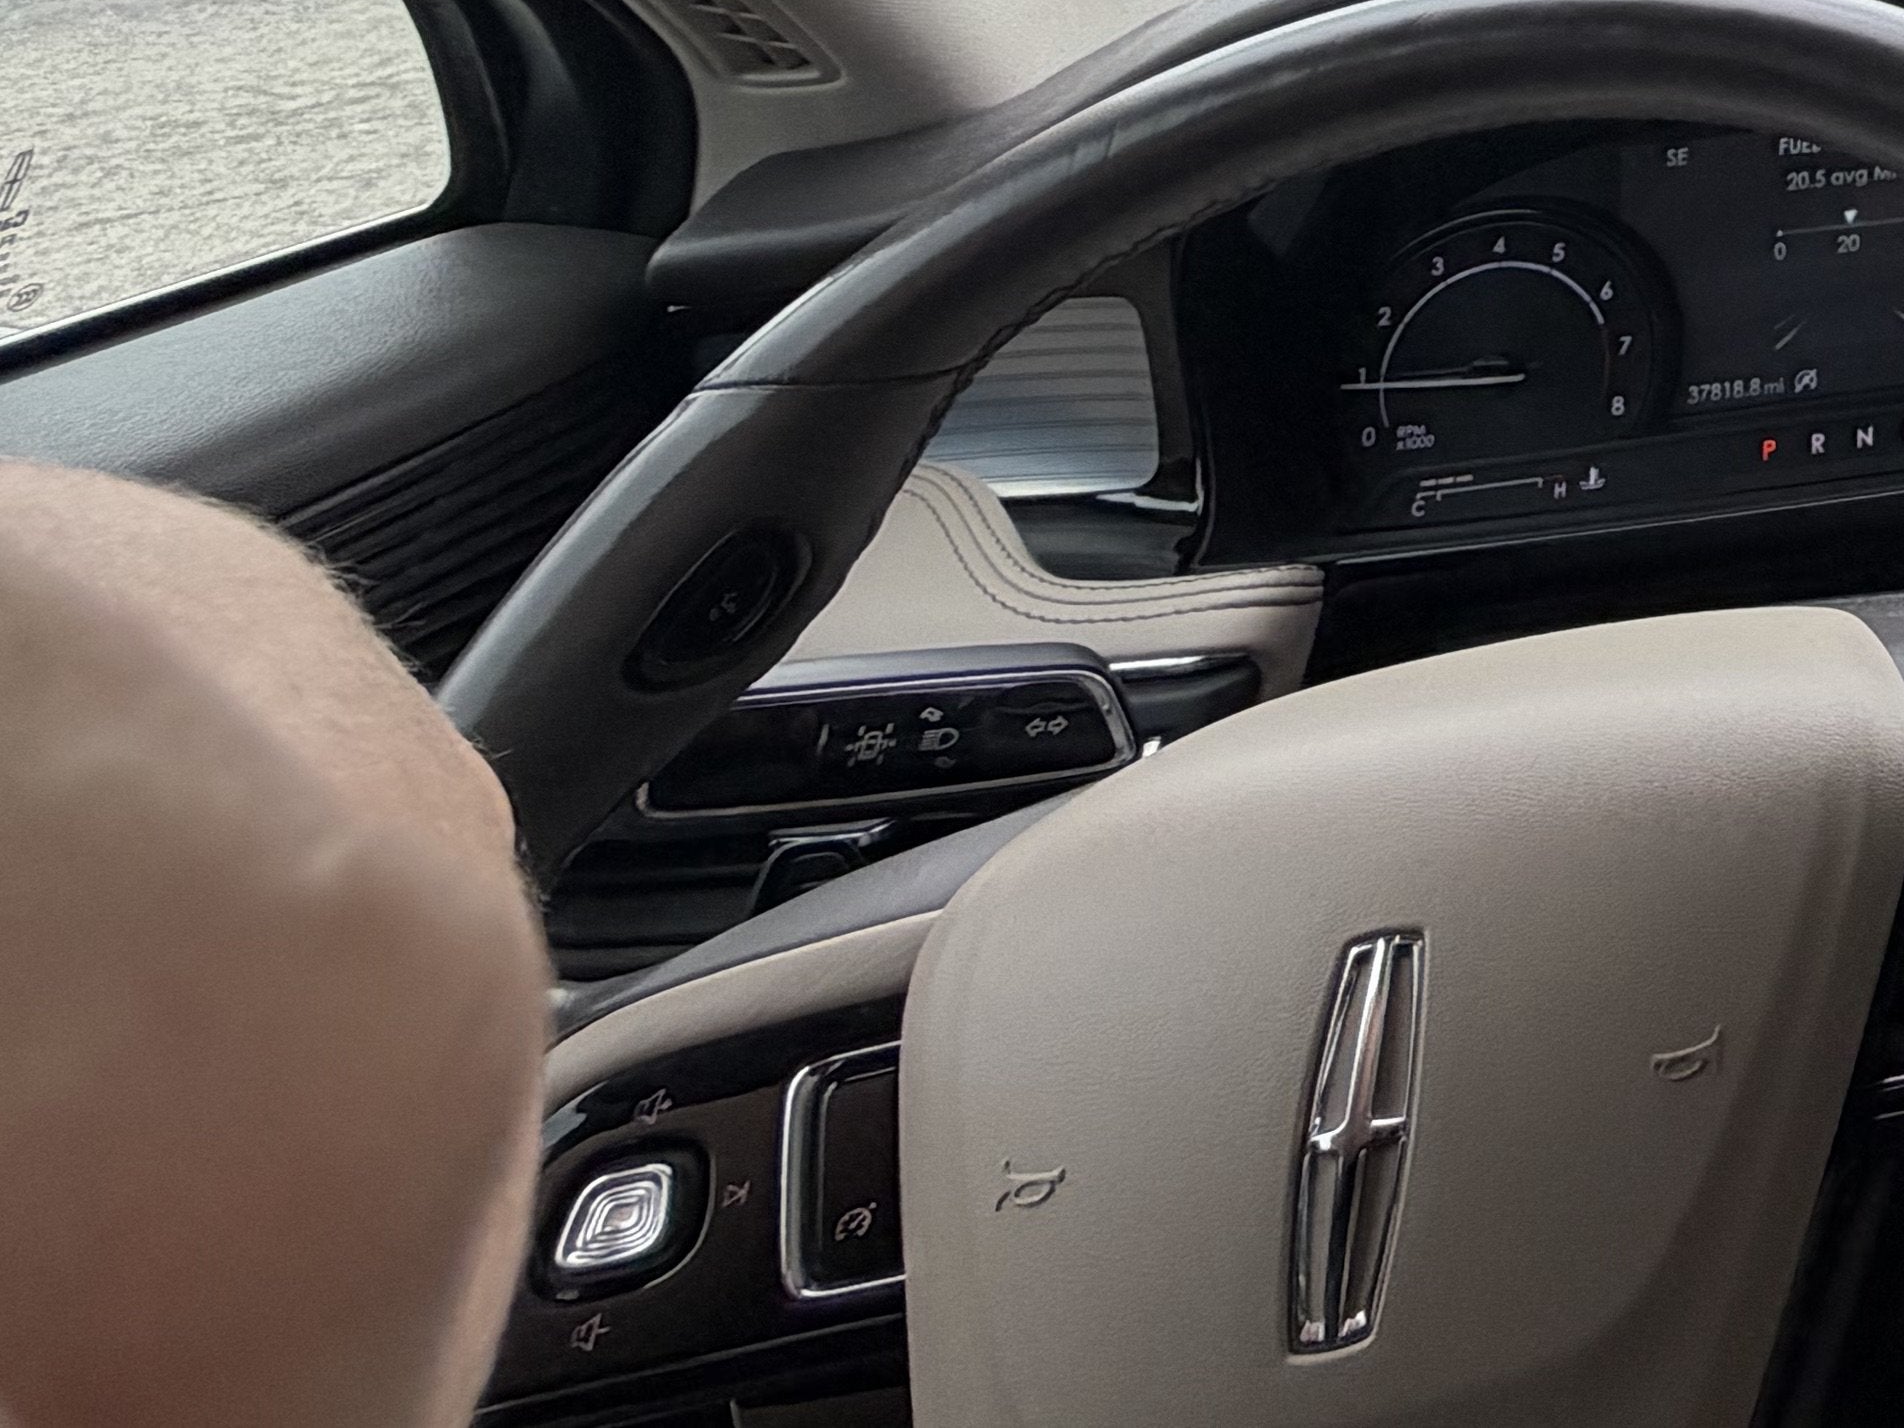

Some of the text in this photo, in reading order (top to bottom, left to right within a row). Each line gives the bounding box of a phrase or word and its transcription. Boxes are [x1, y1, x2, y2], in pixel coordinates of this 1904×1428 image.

[1665, 146, 1690, 168] SE
[1785, 167, 1828, 193] 20.5
[1829, 168, 1869, 189] avg
[1491, 234, 1507, 255] 4
[1550, 241, 1567, 263] 5
[1772, 240, 1789, 262] 0
[1835, 232, 1862, 255] 20
[1430, 255, 1446, 277] 3
[1599, 278, 1615, 302] 6
[1376, 305, 1393, 328] 2
[1616, 334, 1633, 357] 7
[1685, 376, 1787, 407] 37818.8 mi
[1609, 394, 1626, 417] 8
[1360, 425, 1377, 448] 0
[1760, 438, 1778, 463] P
[1810, 431, 1827, 456] R
[1855, 424, 1875, 450] N
[1552, 479, 1568, 500] H
[1410, 498, 1427, 518] C
